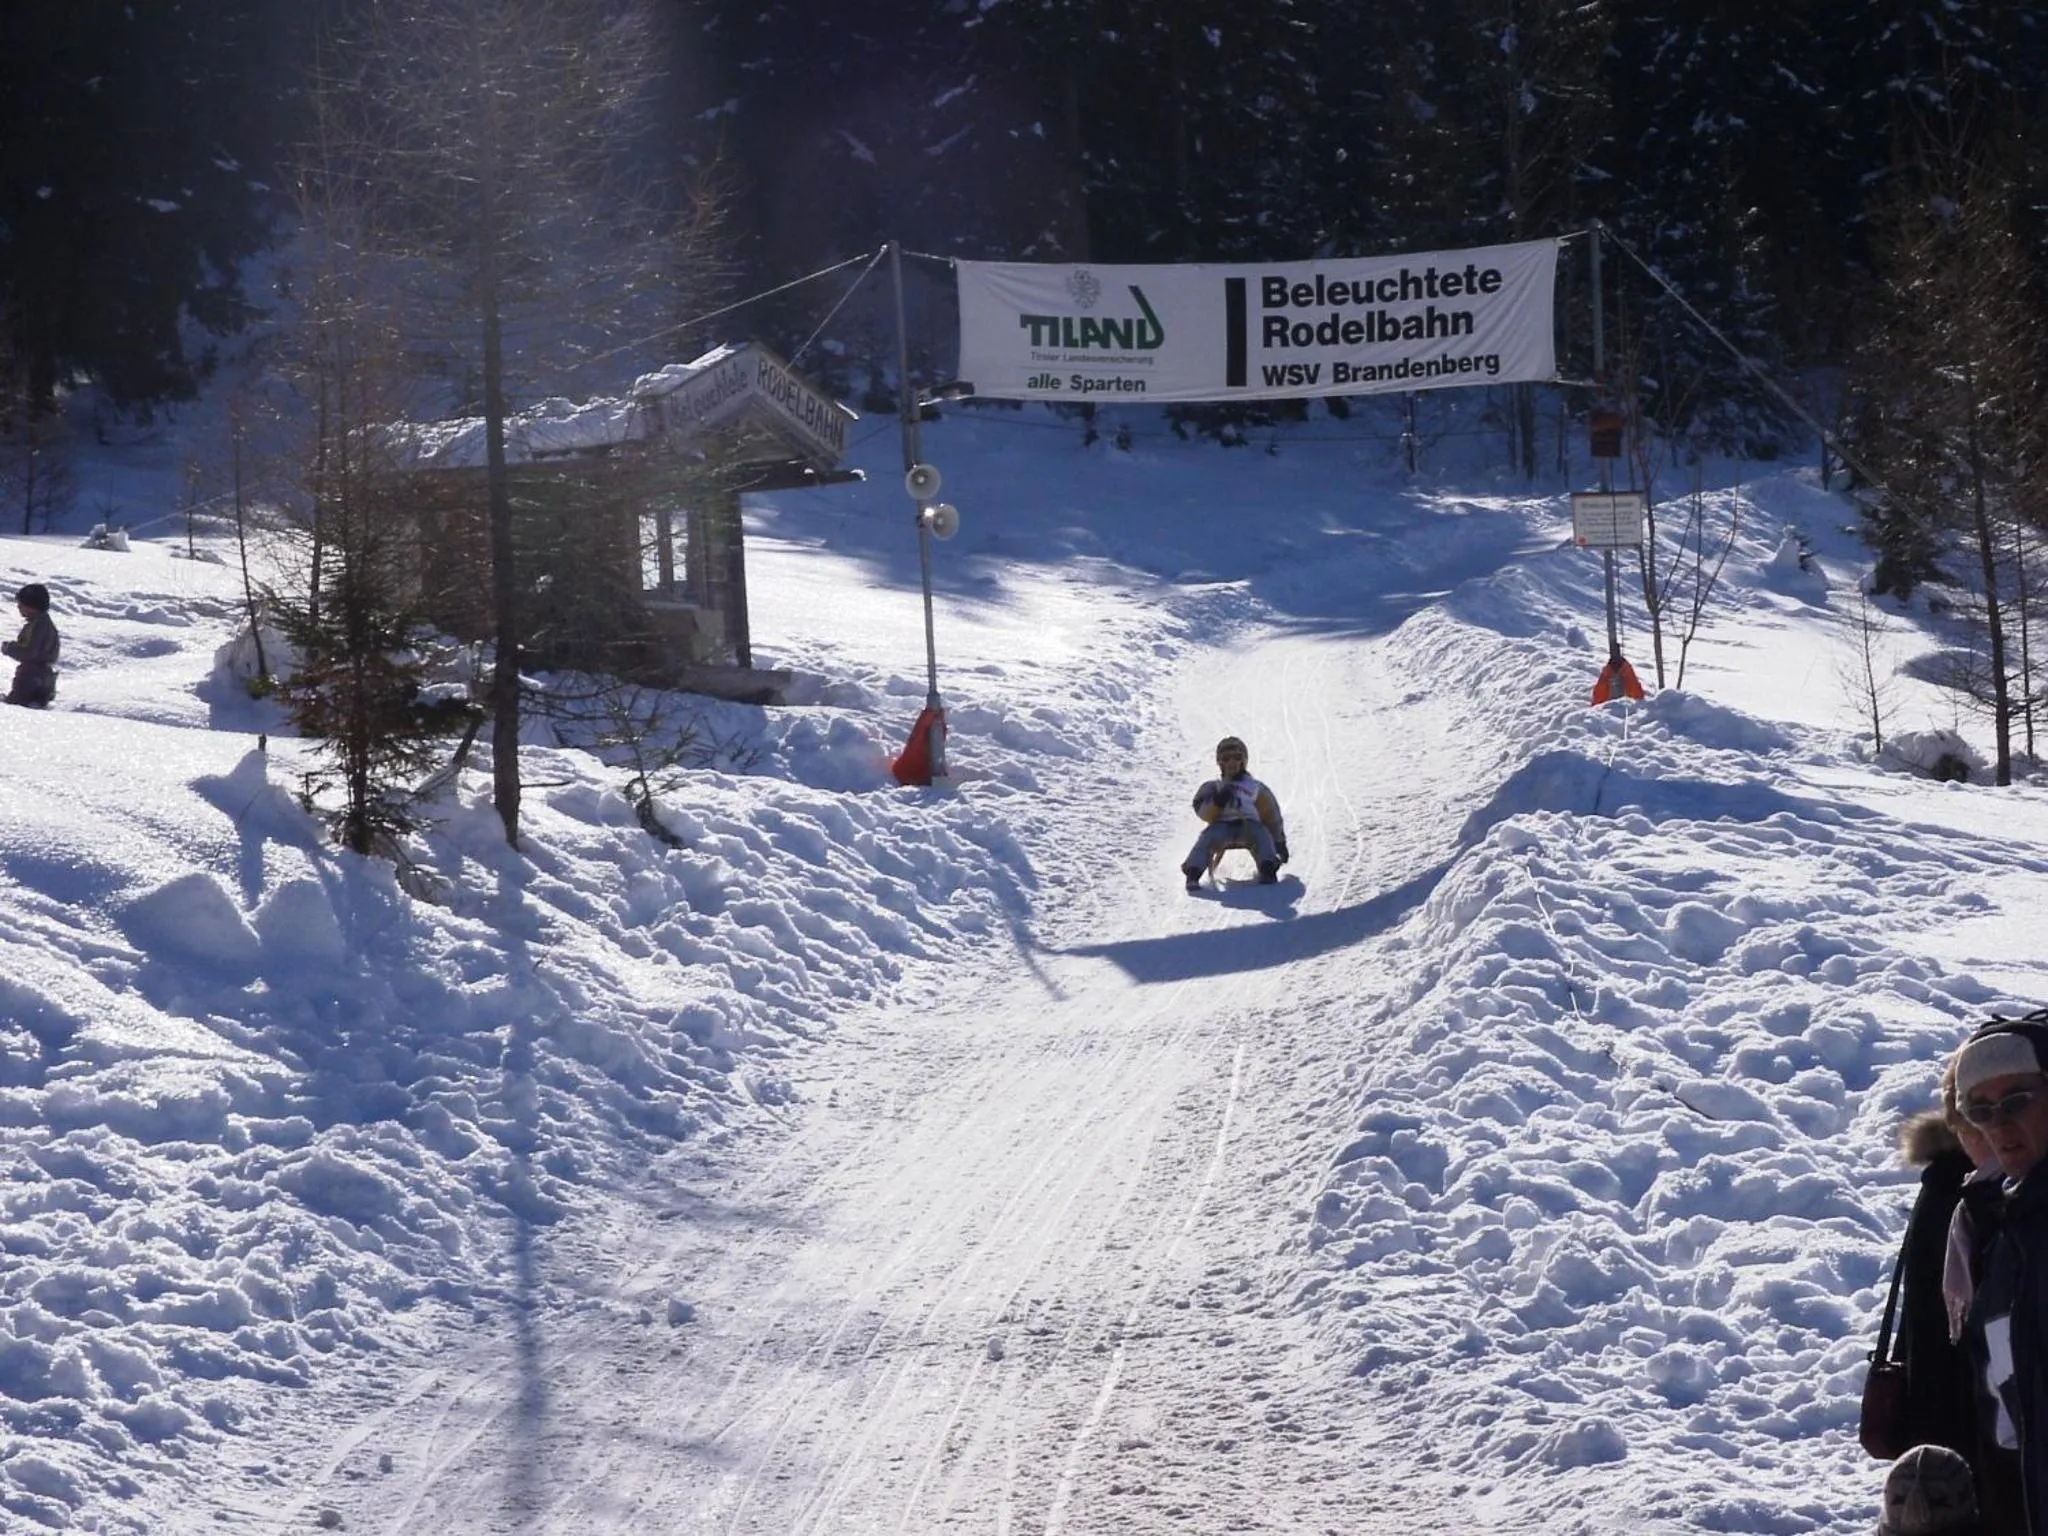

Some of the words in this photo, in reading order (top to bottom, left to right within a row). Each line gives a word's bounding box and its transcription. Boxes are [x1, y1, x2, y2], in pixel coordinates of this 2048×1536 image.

[1262, 264, 1502, 308] Beleuchtete
[1020, 284, 1164, 350] TILAND
[1262, 305, 1475, 349] Rodelbahn
[1028, 373, 1062, 389] alle
[1070, 374, 1146, 394] Sparten
[1262, 362, 1321, 387] WSV
[1332, 353, 1501, 384] Brandenberg
[756, 357, 845, 451] RODELBAHN
